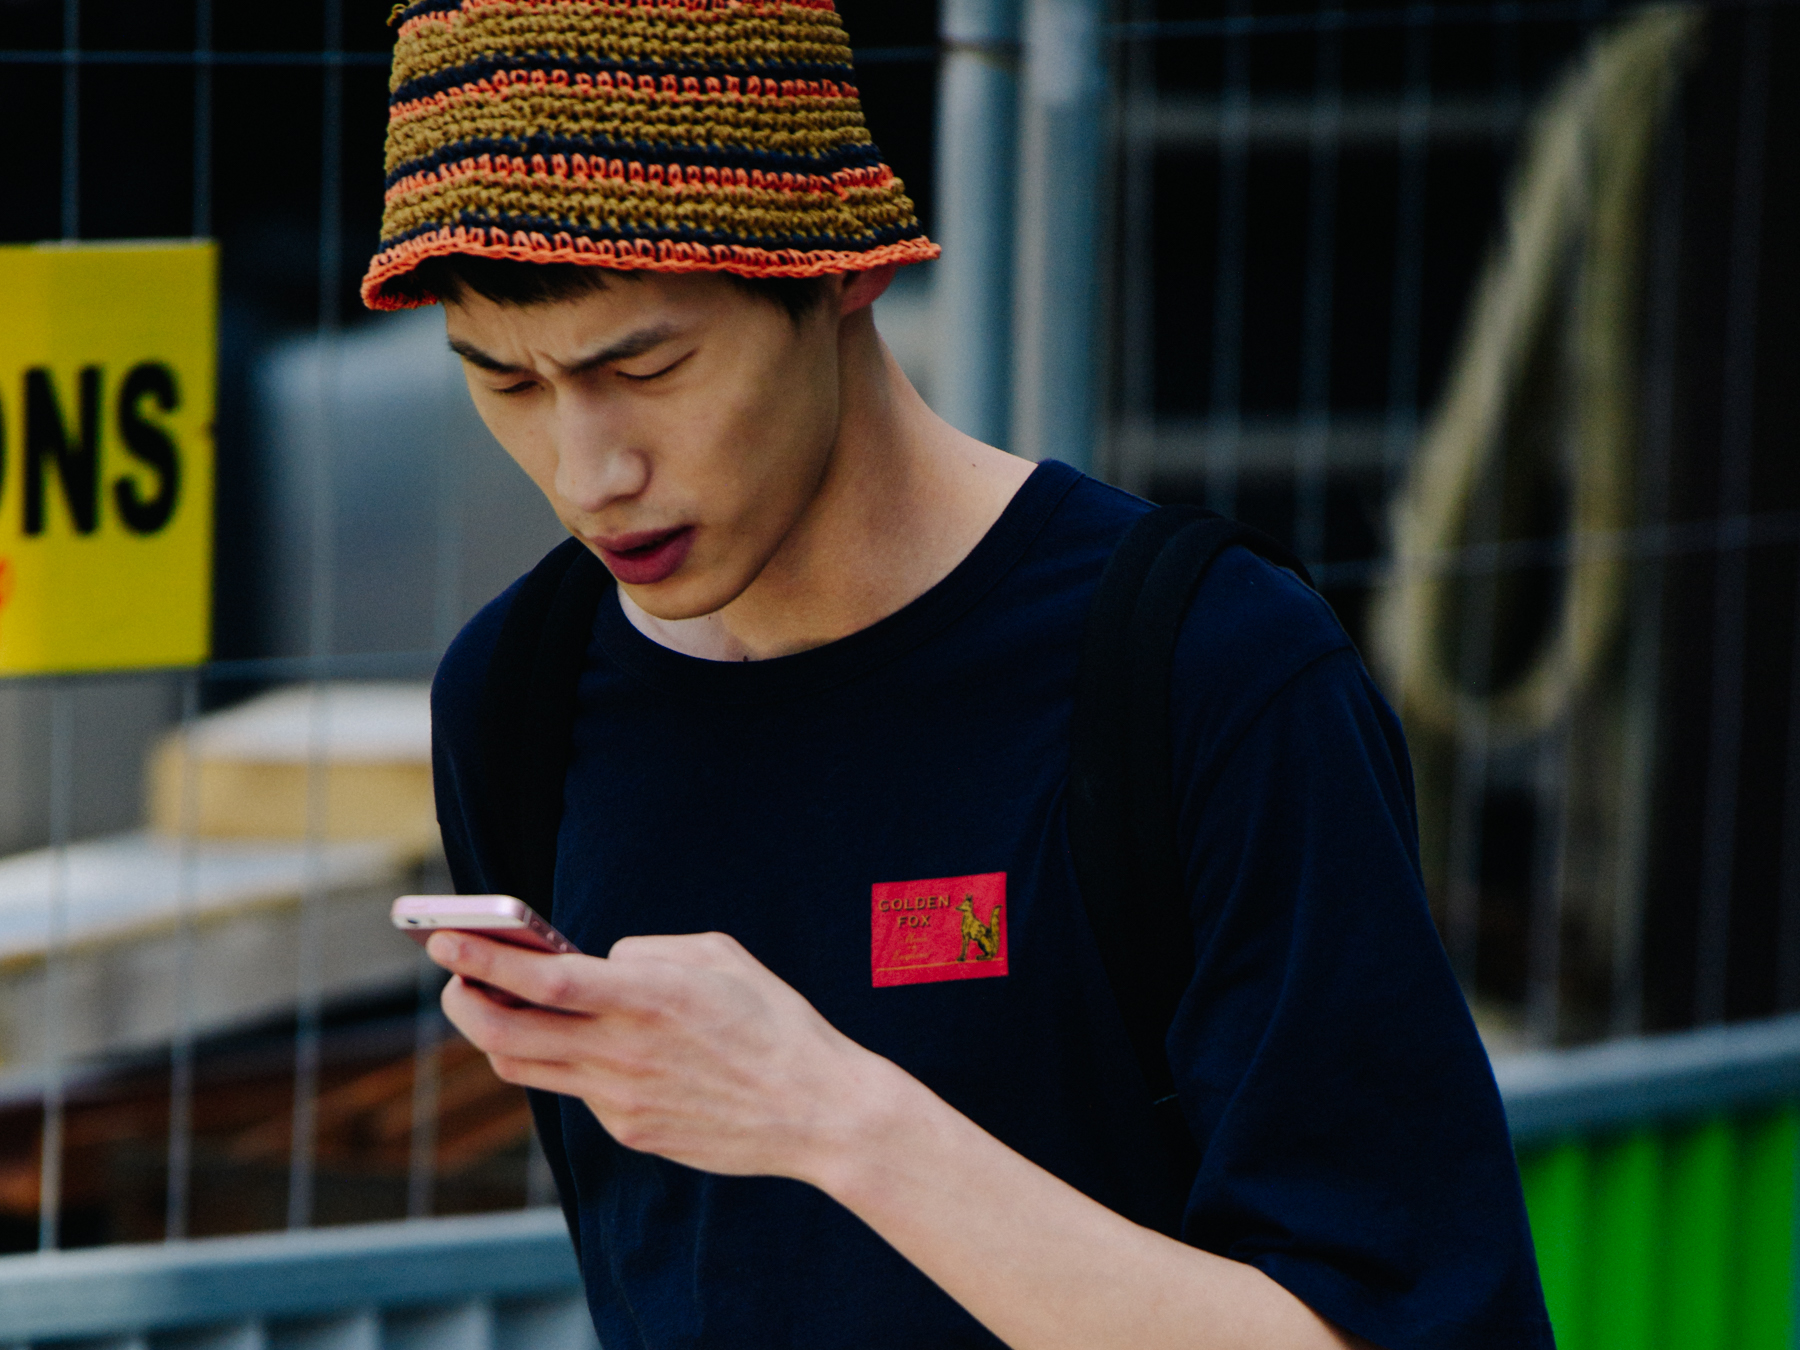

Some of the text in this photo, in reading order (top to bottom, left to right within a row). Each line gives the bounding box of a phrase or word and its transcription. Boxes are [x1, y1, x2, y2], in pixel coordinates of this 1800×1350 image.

[0, 360, 182, 537] NS
[879, 895, 951, 912] GOLDEN
[897, 915, 931, 928] FOX
